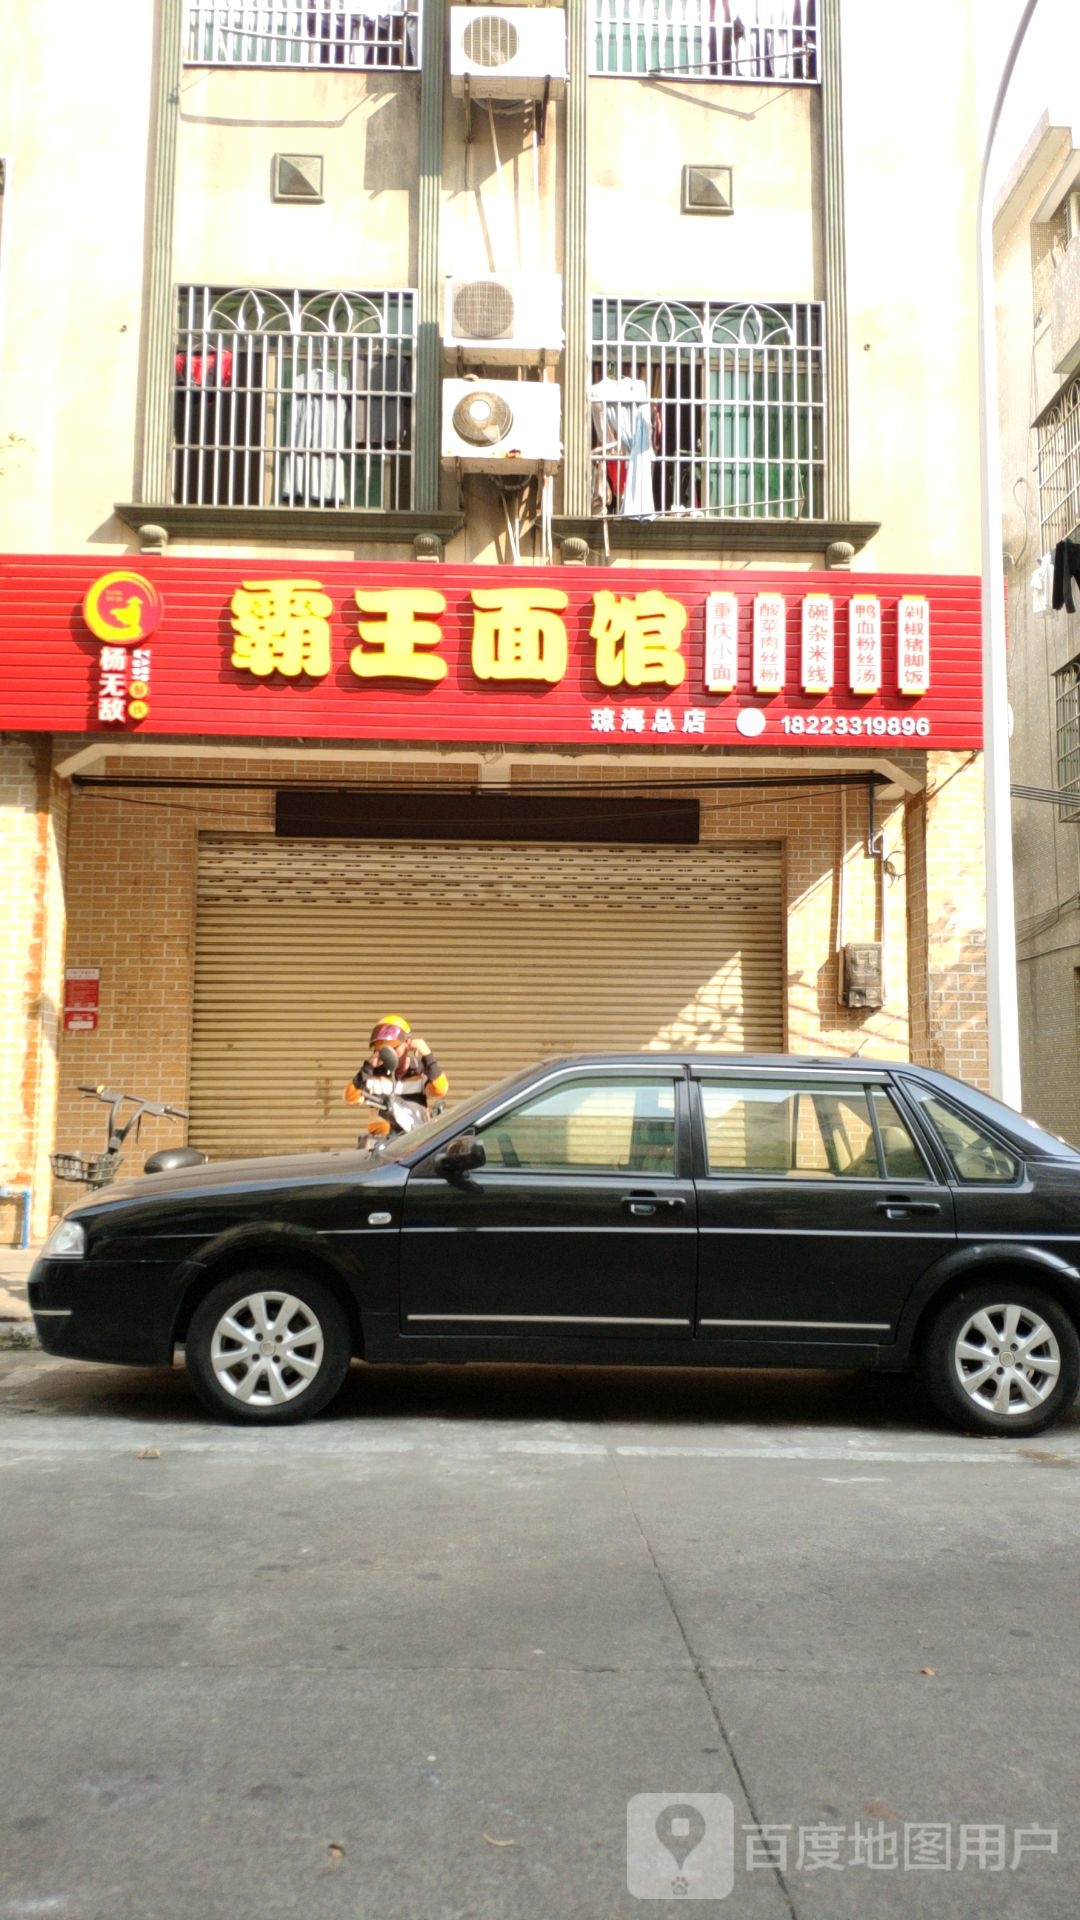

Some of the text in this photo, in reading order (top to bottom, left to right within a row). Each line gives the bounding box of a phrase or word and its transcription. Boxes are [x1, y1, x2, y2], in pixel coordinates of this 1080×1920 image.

[230, 579, 688, 686] 霸王面馆
[712, 603, 732, 680] 重庆小面
[760, 603, 779, 682] 酸菜肉丝粉
[808, 604, 828, 683] 碗杂米线
[855, 605, 876, 683] 鸭血粉丝汤
[904, 606, 924, 684] 剁椒猪脚饭
[99, 646, 126, 722] 杨无敌
[591, 708, 706, 733] 琼海总店
[781, 715, 930, 736] 18223319896
